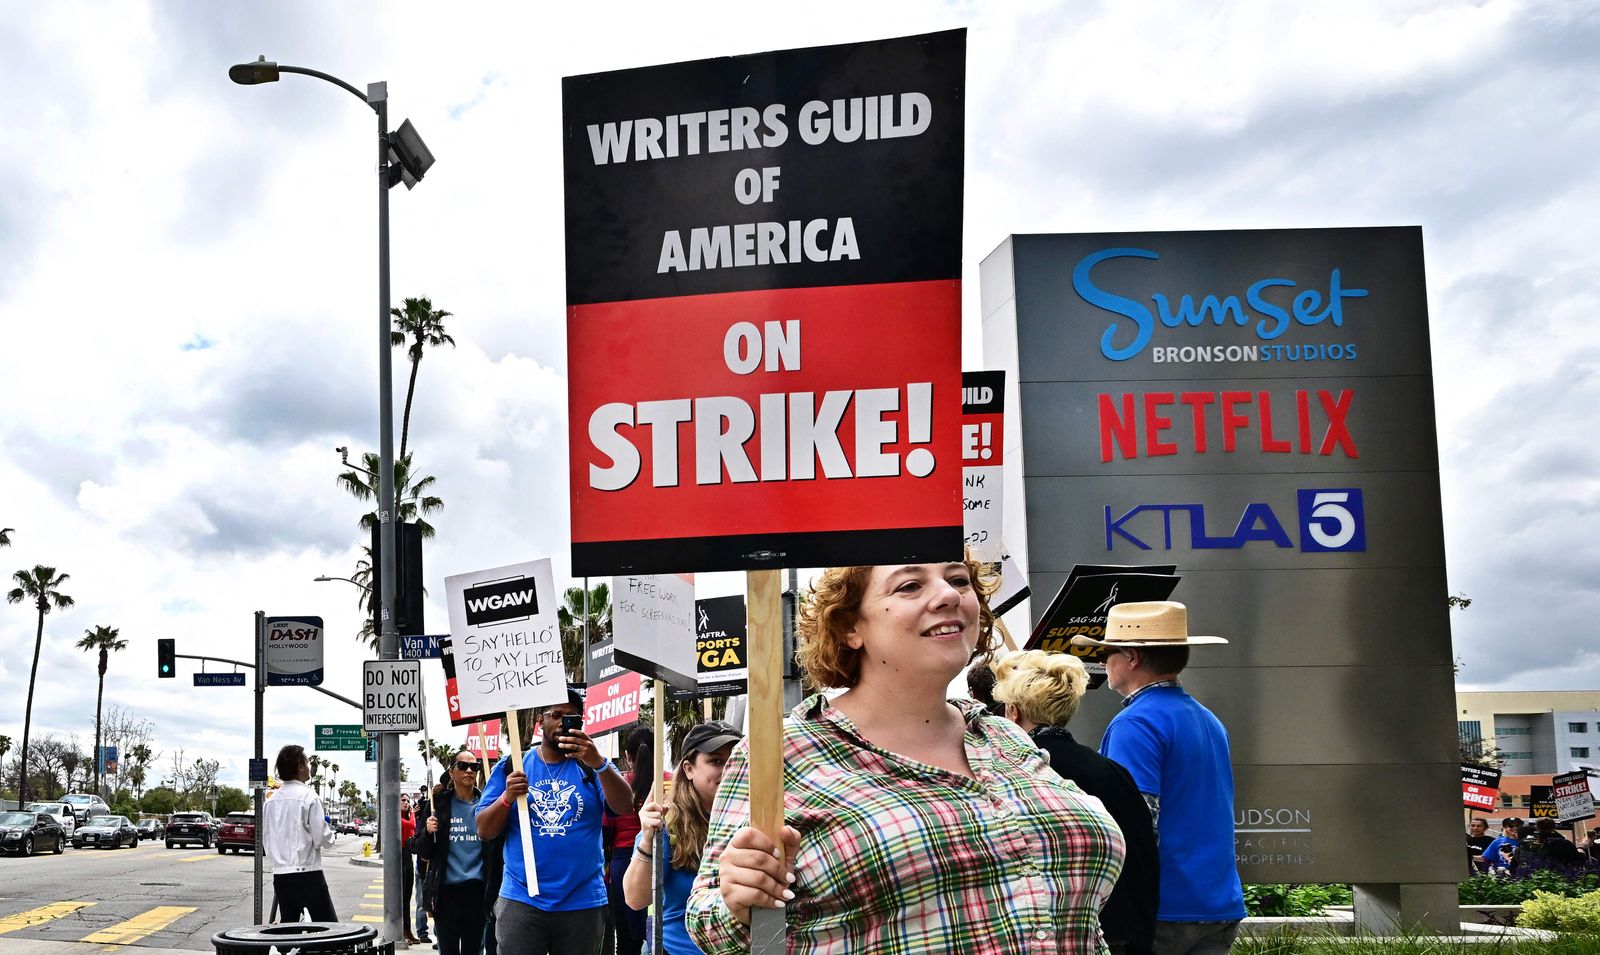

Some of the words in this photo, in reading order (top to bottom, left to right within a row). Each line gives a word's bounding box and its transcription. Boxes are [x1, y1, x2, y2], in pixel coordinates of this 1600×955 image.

[586, 103, 789, 165] WRITERS
[798, 92, 932, 145] GUILD
[735, 166, 781, 205] OF
[657, 217, 860, 273] AMERICA
[1072, 247, 1369, 361] Sunset
[723, 319, 801, 375] ON
[1152, 345, 1258, 363] BRONSON
[1260, 343, 1358, 361] STUDIOS
[962, 386, 993, 405] UILD
[1097, 389, 1360, 463] NETFLIX
[588, 381, 937, 492] STRIKE!
[1104, 503, 1294, 551] KTLA
[1308, 492, 1356, 548] 5
[628, 577, 656, 599] FREE
[467, 589, 533, 614] WGAW
[620, 600, 639, 616] FOR
[270, 628, 319, 641] DASH
[1047, 626, 1105, 638] SUPPO
[404, 637, 423, 649] Van
[464, 634, 498, 654] SAY
[592, 643, 613, 660] WRITE
[697, 637, 741, 650] PORTS
[404, 649, 422, 658] 1400
[425, 649, 431, 657] N
[463, 657, 482, 671] TO
[494, 651, 521, 668] MY
[525, 650, 563, 666] LITTLE
[696, 648, 741, 667] GA
[197, 676, 210, 684] Van
[212, 676, 231, 684] Ness
[234, 676, 242, 684] Av
[366, 670, 384, 686] DO
[391, 669, 417, 686] NOT
[477, 665, 549, 694] STRIKE
[607, 683, 620, 697] ON
[366, 692, 417, 709] BLOCK
[586, 690, 637, 725] STRIKE!
[366, 713, 418, 725] INTERSECTION
[467, 735, 499, 751] STRKE!
[1461, 766, 1481, 775] RITERS
[1481, 769, 1498, 778] GUILD
[559, 779, 569, 787] OF
[1461, 777, 1487, 786] AMERICA
[1468, 786, 1479, 794] ON
[1556, 782, 1587, 797] STRIKE!
[1463, 792, 1493, 806] RIKE!
[1234, 808, 1311, 825] UDSON
[1533, 808, 1558, 818] WG
[1234, 854, 1314, 865] PROPERTIES
